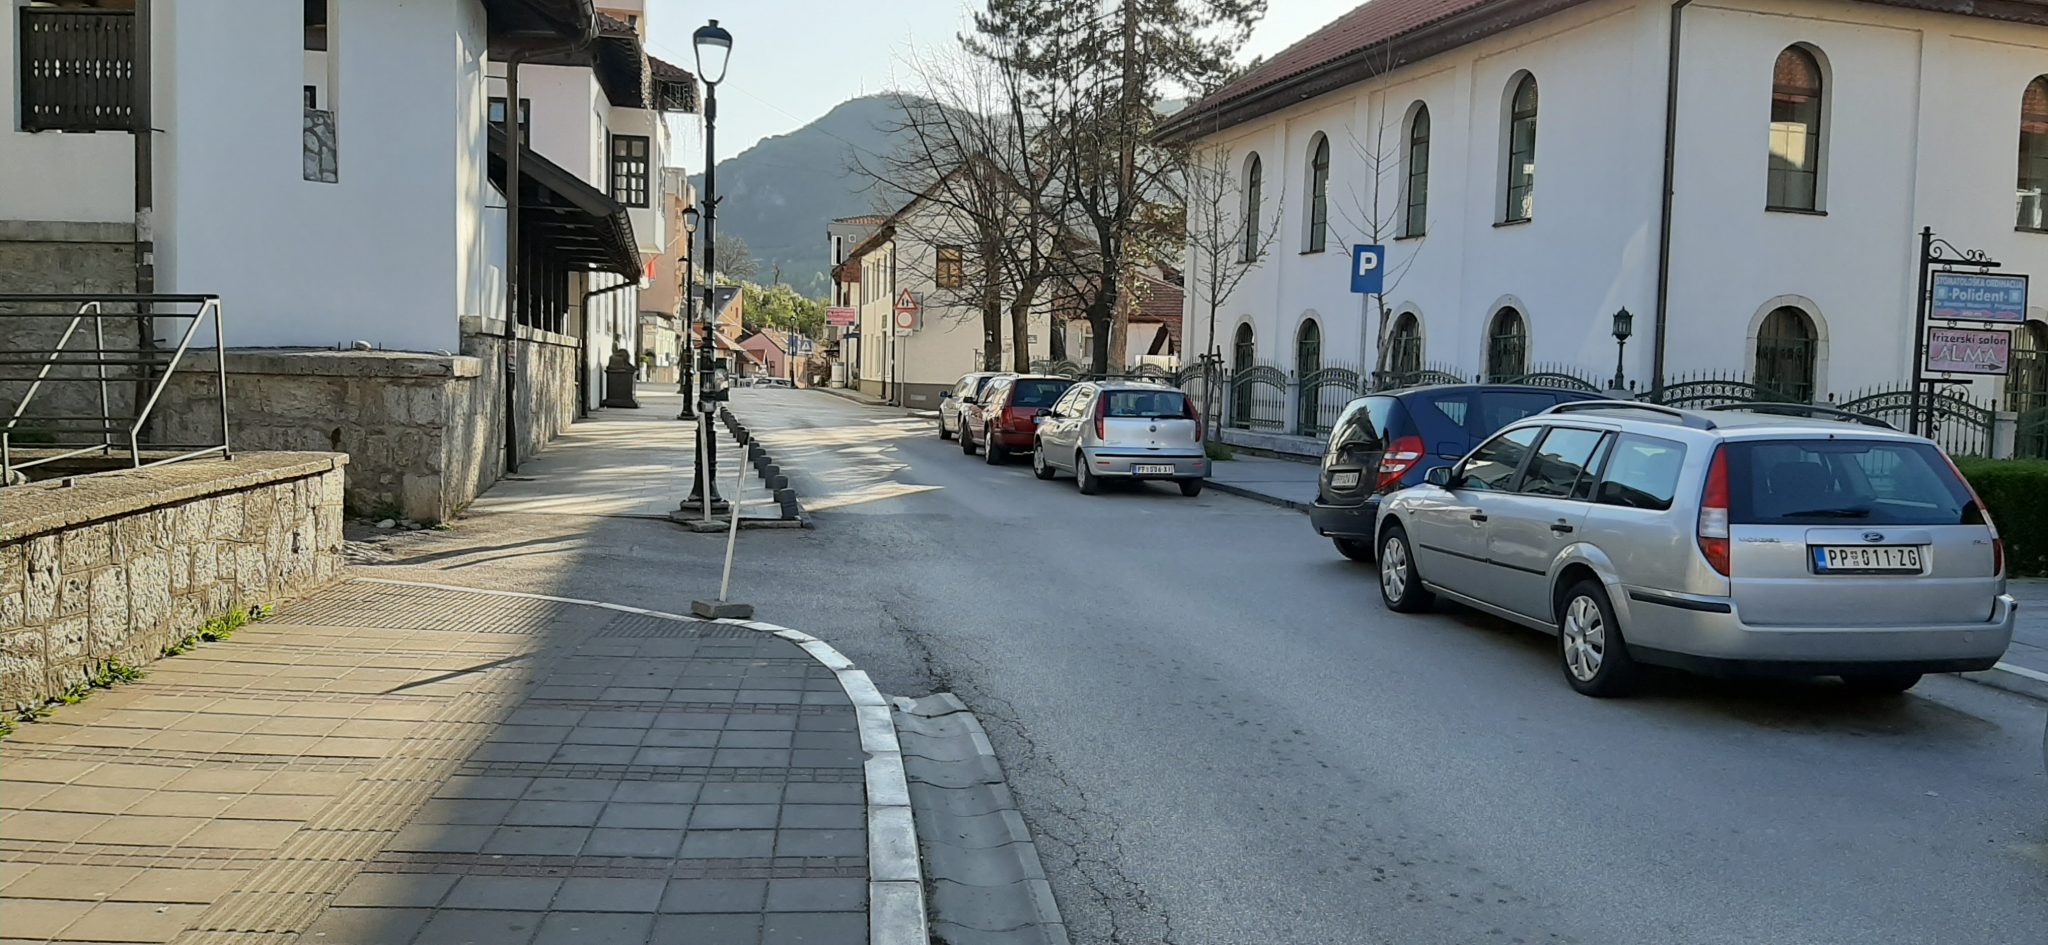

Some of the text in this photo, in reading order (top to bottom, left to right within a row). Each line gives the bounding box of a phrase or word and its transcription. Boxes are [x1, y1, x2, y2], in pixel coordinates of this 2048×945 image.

[1359, 251, 1378, 276] P
[1932, 332, 2007, 345] frizerski salon
[1937, 343, 1997, 363] ALMA
